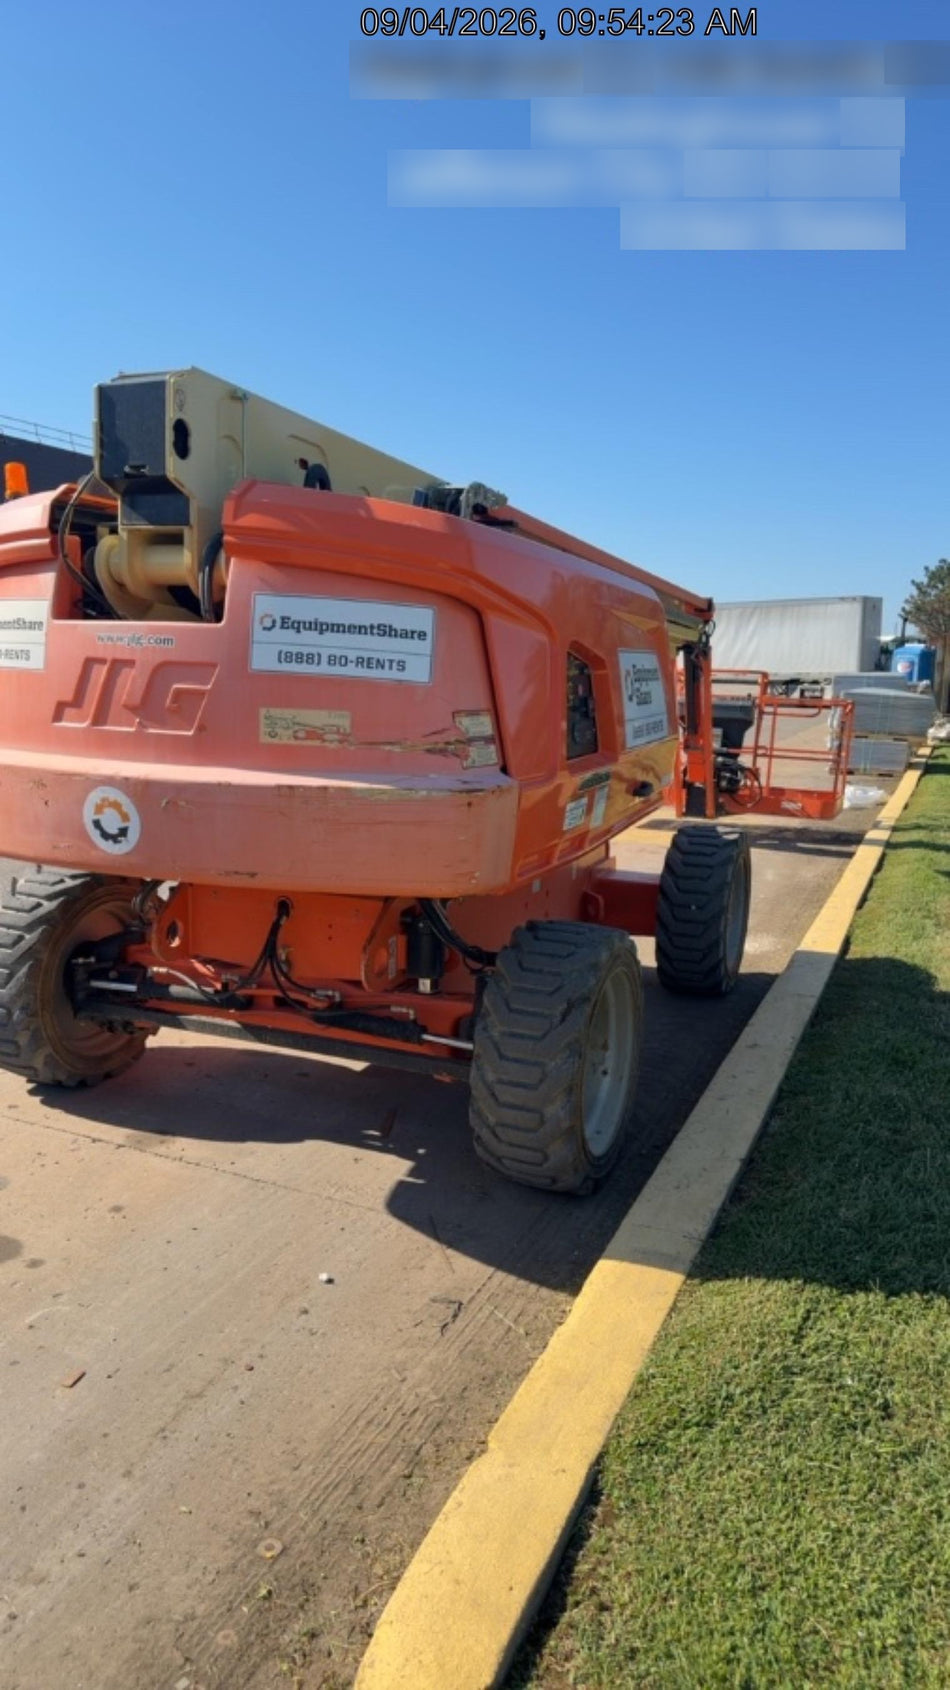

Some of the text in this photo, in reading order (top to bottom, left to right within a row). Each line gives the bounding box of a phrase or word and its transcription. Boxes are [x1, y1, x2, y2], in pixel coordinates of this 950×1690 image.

[279, 615, 428, 641] EquipmentShare
[277, 649, 407, 673] (888) 80-RENTS
[52, 656, 221, 736] JLG
